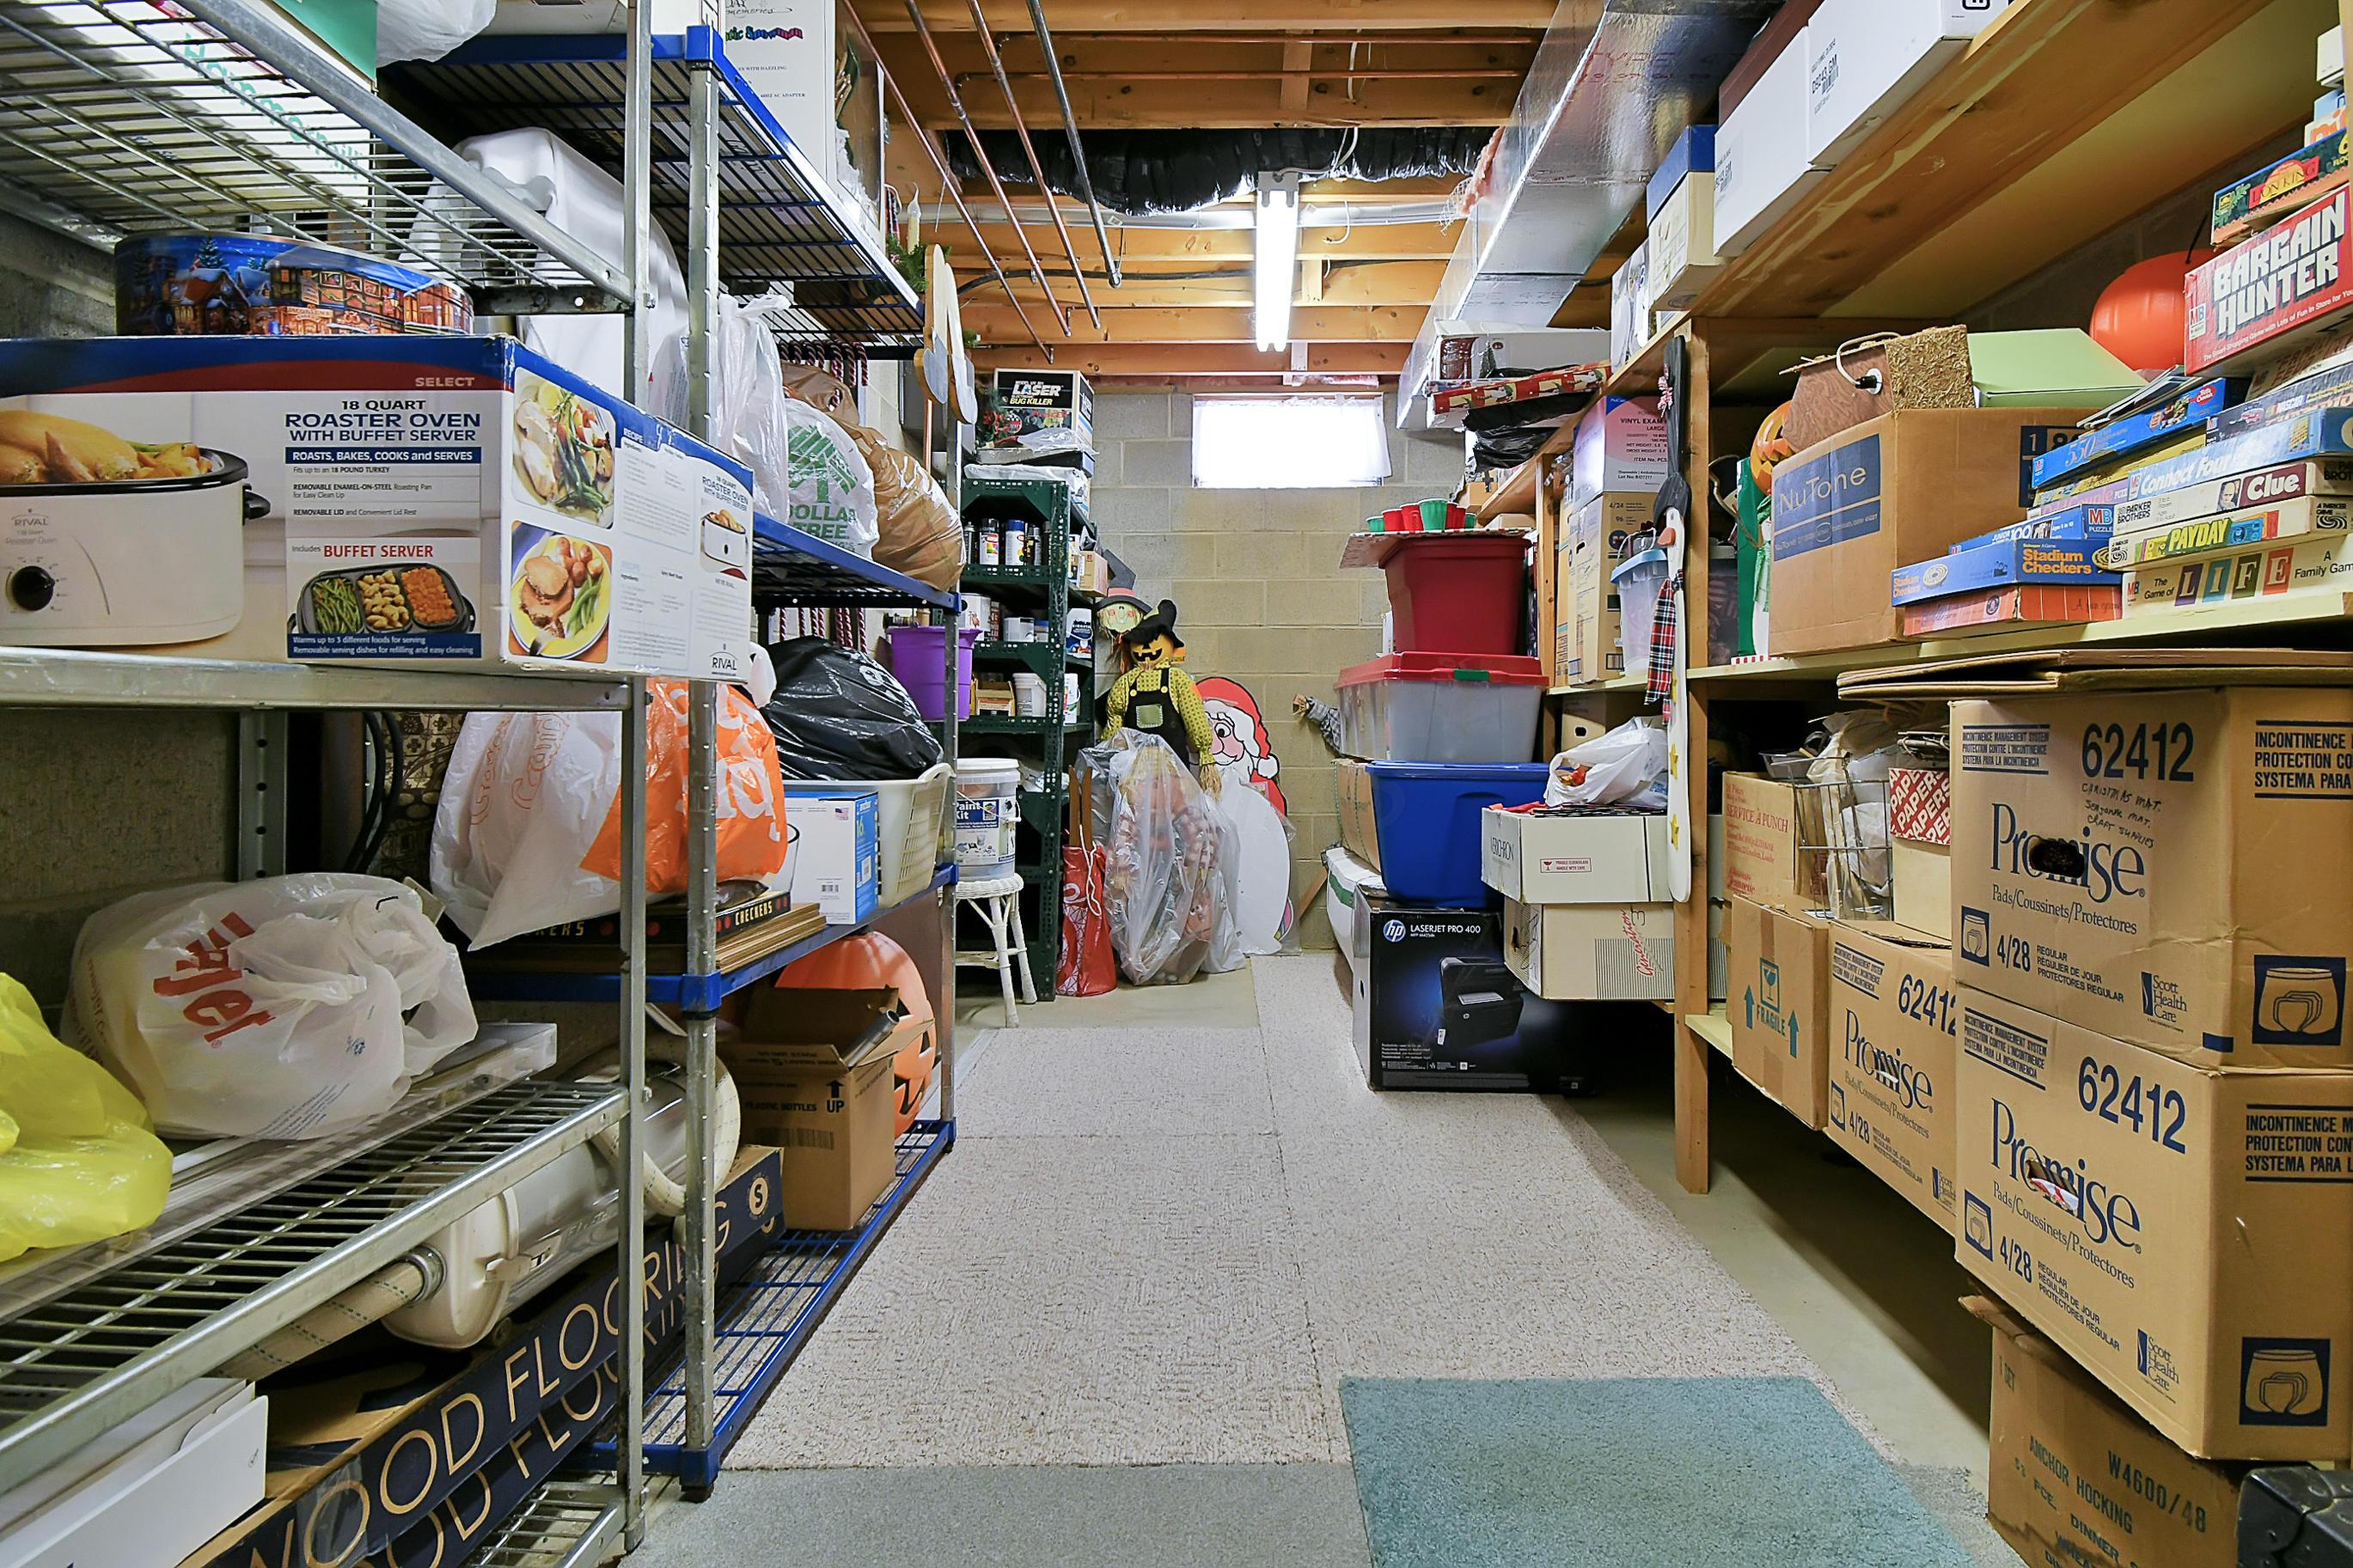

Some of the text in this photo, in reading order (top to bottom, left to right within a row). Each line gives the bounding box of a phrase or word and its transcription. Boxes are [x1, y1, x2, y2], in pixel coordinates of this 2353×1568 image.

[2214, 191, 2345, 302] BARGAIN
[2218, 241, 2338, 336] HUNTER
[2296, 308, 2307, 319] Fun
[2315, 298, 2332, 310] Store
[415, 377, 474, 387] SELECT
[1012, 384, 1062, 396] LASER
[342, 400, 426, 412] 18 QUART
[285, 413, 480, 427] ROASTER OVEN
[290, 430, 476, 441] WITH BUFFET SERVER
[293, 452, 473, 461] ROASTS, BAKES, COOKS and SERVES
[2141, 452, 2229, 496] Connect Four
[702, 476, 748, 504] ROASTER OVEN
[1780, 467, 1867, 515] NuTone
[2247, 473, 2299, 500] Clue
[2118, 511, 2151, 524] BROTHERS
[2126, 501, 2152, 513] PARKER
[15, 518, 48, 527] RIVAL
[1992, 532, 2011, 541] JUNIOR
[2168, 518, 2230, 552] PAYDAY
[324, 546, 376, 558] BUFFET
[381, 546, 433, 558] SERVER
[2022, 548, 2083, 563] Stadium
[2324, 551, 2331, 561] A
[2022, 562, 2092, 575] Checkers
[2145, 556, 2289, 600] Game of LIFE
[2295, 565, 2326, 578] Family
[2128, 578, 2167, 596] MB The
[389, 646, 413, 655] refilling
[446, 646, 474, 655] cleaning
[712, 656, 736, 670] RIVAL
[1989, 744, 2006, 753] CONTRE
[2255, 732, 2346, 749] INCONTINENCE
[1995, 756, 2001, 766] LA
[2081, 722, 2194, 783] 62412
[2255, 752, 2332, 769] PROTECTION
[2255, 772, 2351, 789] SYSTEMA PARA
[2081, 784, 2132, 802] CHRISTMAS
[1727, 804, 1788, 833] SERVICE PUNCH
[1990, 802, 2144, 903] Proise
[735, 900, 773, 927] CHECKERS
[1992, 884, 2137, 935] Pads/Coussinets/Protectores
[1386, 921, 1404, 940] hp
[1410, 924, 1445, 933] LASERJET
[1620, 909, 1654, 977] Generation
[1997, 935, 2031, 972] 4/28
[2037, 945, 2068, 961] REGULAR
[2038, 967, 2124, 1003] PROTECTORES REGULAR
[2070, 968, 2102, 984] DE JOUR
[2153, 975, 2179, 994] Scott
[2154, 991, 2187, 1012] Health
[1757, 1004, 1786, 1036] FRAGILE
[2154, 1006, 2177, 1022] Care
[1843, 1008, 1933, 1109] Promise
[780, 1103, 816, 1112] BOTTLES
[827, 1100, 845, 1113] UP
[2078, 1056, 2186, 1154] 62412
[1849, 1111, 1870, 1144] 4/28
[2246, 1115, 2337, 1132] INCONTINENCE
[2246, 1135, 2321, 1152] PROTECTION
[2246, 1155, 2342, 1172] SYSTEMA PARA
[1994, 1181, 2135, 1289] Pads/Coussinets/Protectores
[2000, 1235, 2032, 1284] 4/28
[2038, 1261, 2067, 1289] REGULAR
[504, 1200, 730, 1423] FLORIG
[2038, 1284, 2120, 1351] PROTECTORES REGULAR
[2070, 1296, 2100, 1325] DE JOUR
[2148, 1337, 2172, 1364] Scott
[2148, 1351, 2179, 1384] Health
[2148, 1366, 2169, 1391] Care
[2030, 1435, 2133, 1534] ANCHOR HOCKING
[2108, 1450, 2207, 1534] W4600/48
[2070, 1513, 2120, 1567] DINNER
